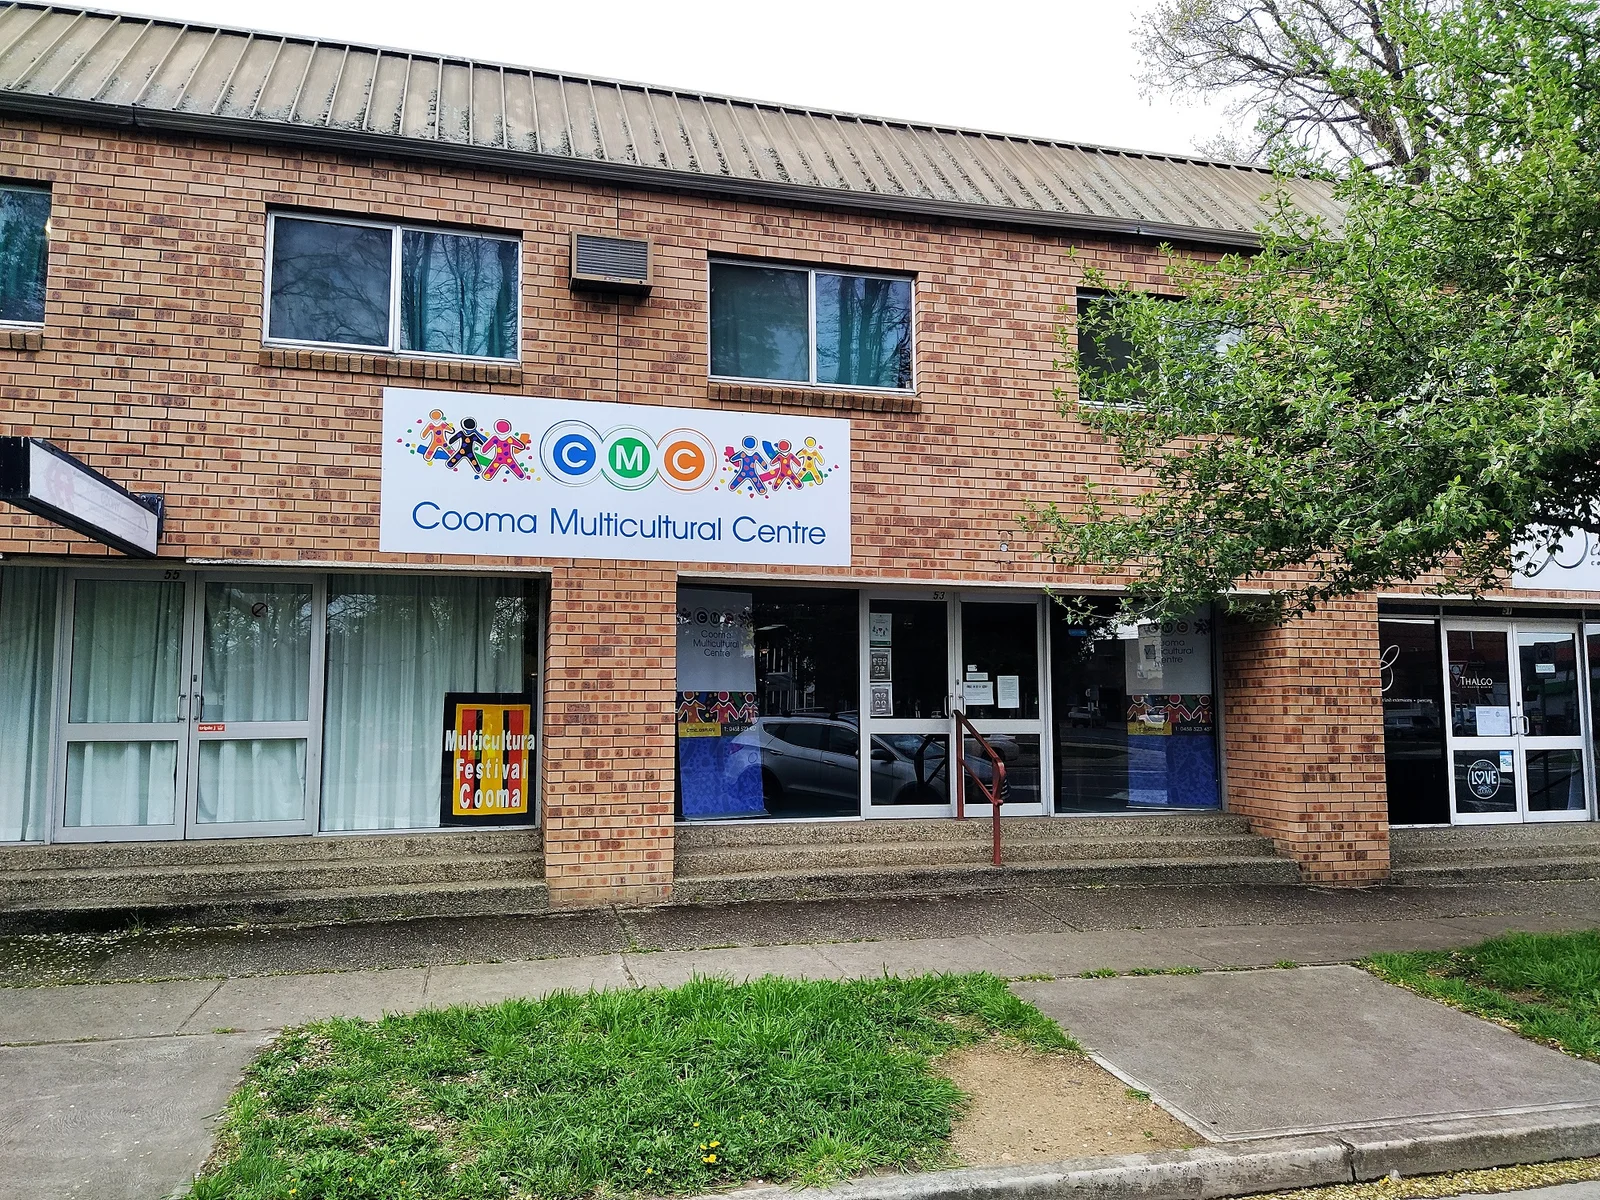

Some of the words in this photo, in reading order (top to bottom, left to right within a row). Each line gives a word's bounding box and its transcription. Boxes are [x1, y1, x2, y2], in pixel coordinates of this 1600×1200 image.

[412, 501, 537, 533] Cooma
[550, 507, 722, 541] Multicultural
[732, 515, 827, 545] Centre
[164, 569, 181, 580] 55
[933, 591, 945, 600] 53
[701, 629, 731, 639] Cooma
[692, 639, 740, 649] Multicultural
[703, 648, 731, 657] Centre
[1460, 676, 1493, 686] THALGO
[445, 730, 535, 751] Multicultura
[456, 758, 527, 780] Festival
[459, 783, 521, 809] Cooma
